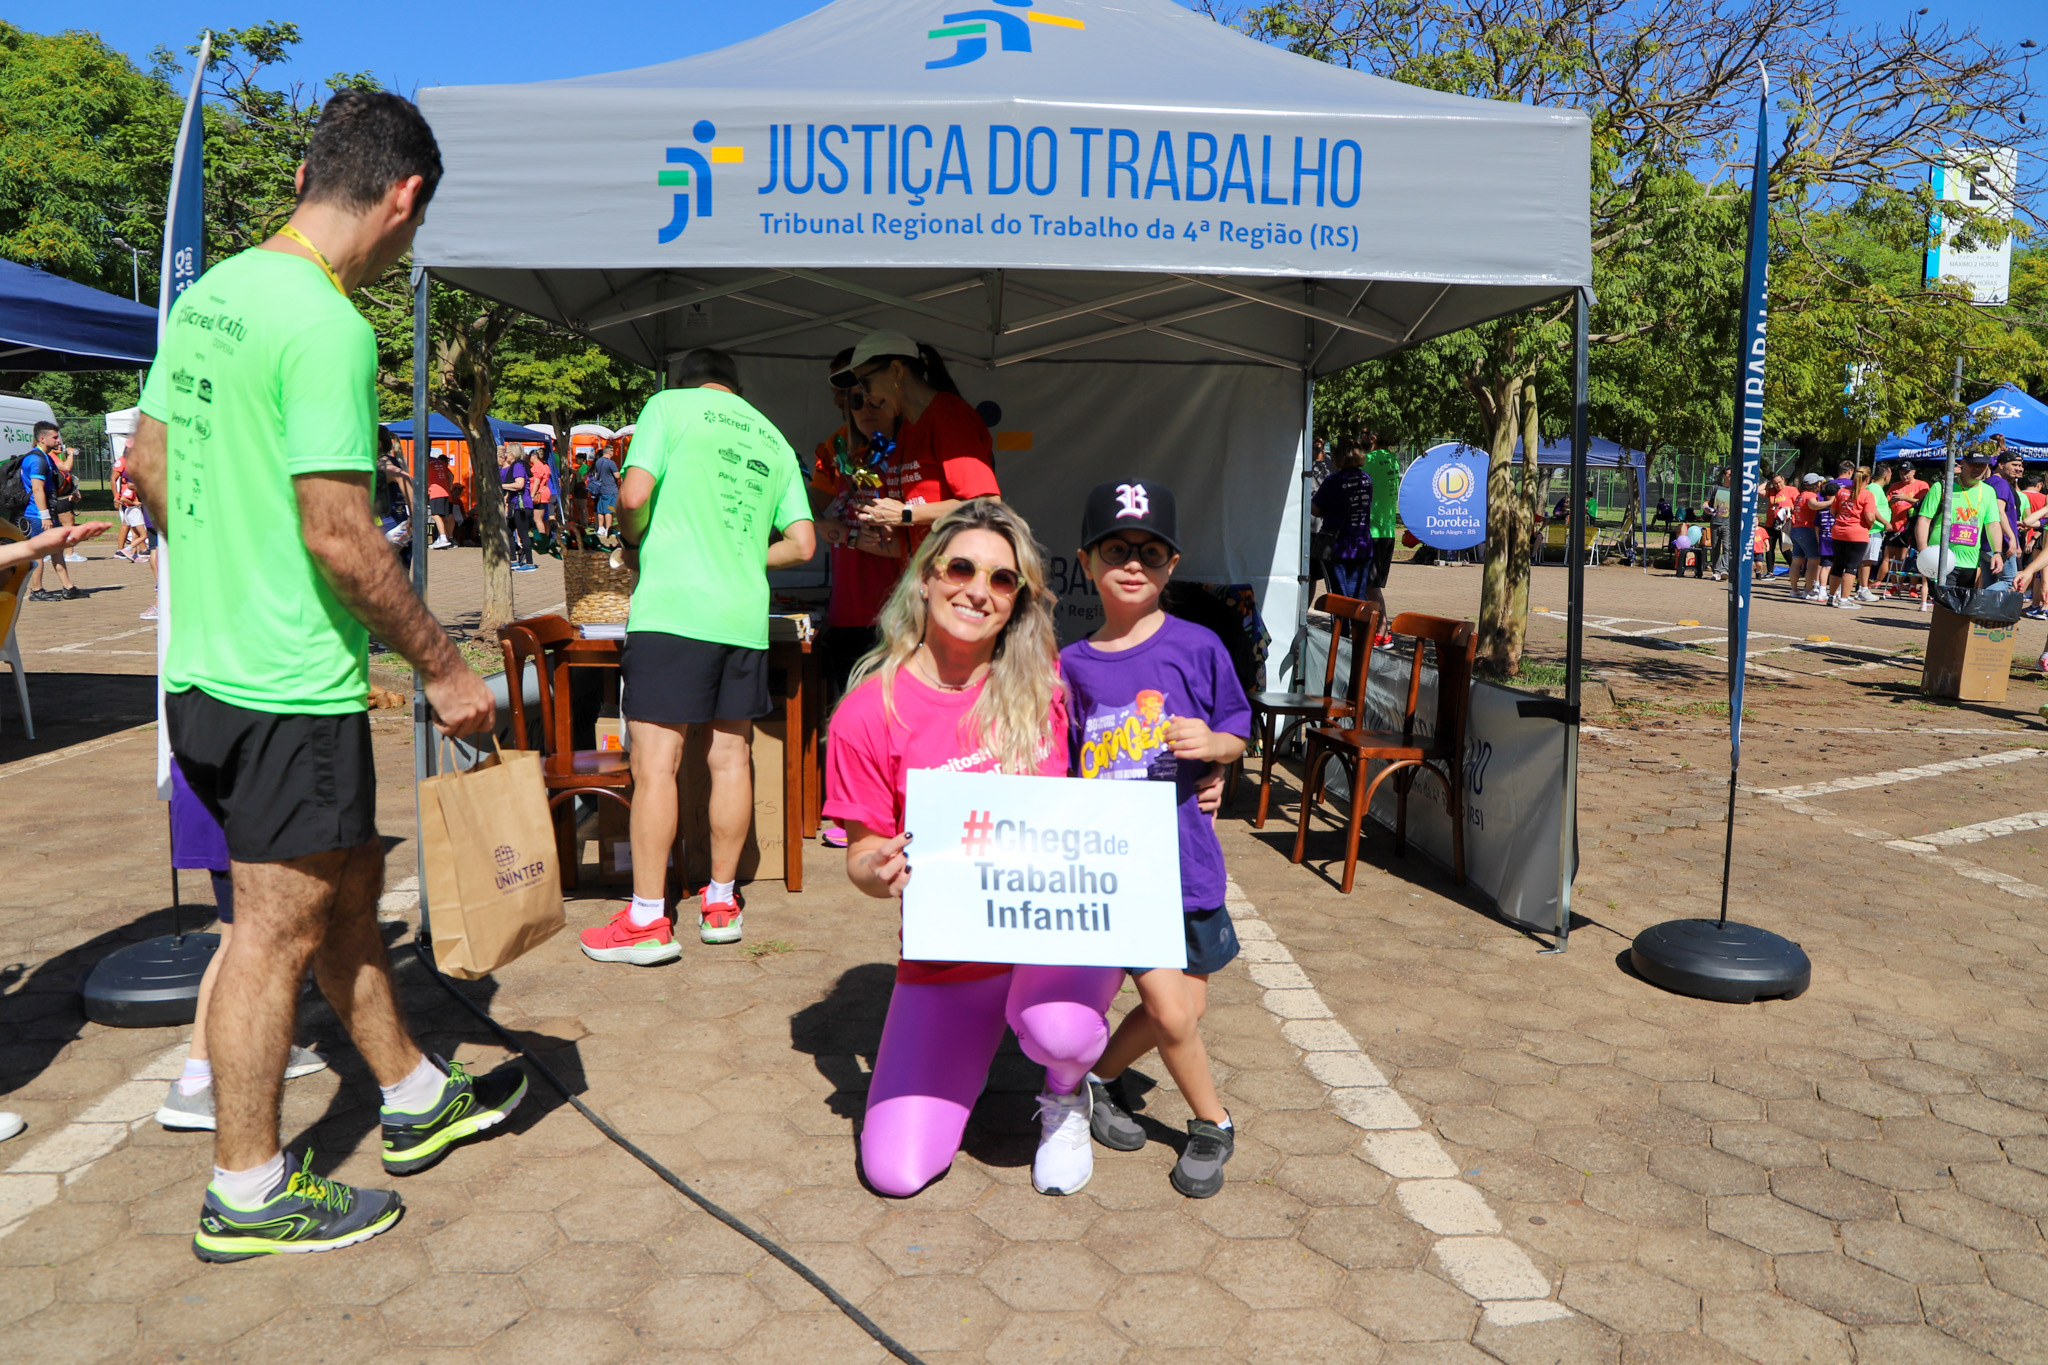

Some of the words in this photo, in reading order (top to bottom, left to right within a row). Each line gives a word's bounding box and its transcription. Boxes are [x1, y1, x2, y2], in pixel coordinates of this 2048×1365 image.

[757, 123, 974, 207] JUSTIÇA
[987, 124, 1060, 197] DO
[1069, 126, 1364, 209] TRABALHO
[759, 211, 866, 236] Tribunal
[872, 212, 985, 241] Regional
[990, 212, 1023, 236] do
[1028, 213, 1139, 240] Trabalho
[1145, 216, 1177, 241] da
[1182, 219, 1211, 243] 4ª
[1219, 220, 1303, 250] Região
[1309, 222, 1361, 253] (RS)
[15, 429, 34, 443] Sicr
[718, 413, 751, 433] Sicredi
[1898, 448, 1922, 459] GRUPO
[1922, 448, 1933, 458] DE
[1425, 516, 1480, 528] Doroteia
[1438, 505, 1468, 515] Santa
[961, 809, 1102, 862] #Chega
[1103, 834, 1129, 856] de
[494, 861, 545, 890] UNINTER
[973, 861, 1119, 895] Trabalho
[986, 898, 1112, 932] Infantil
